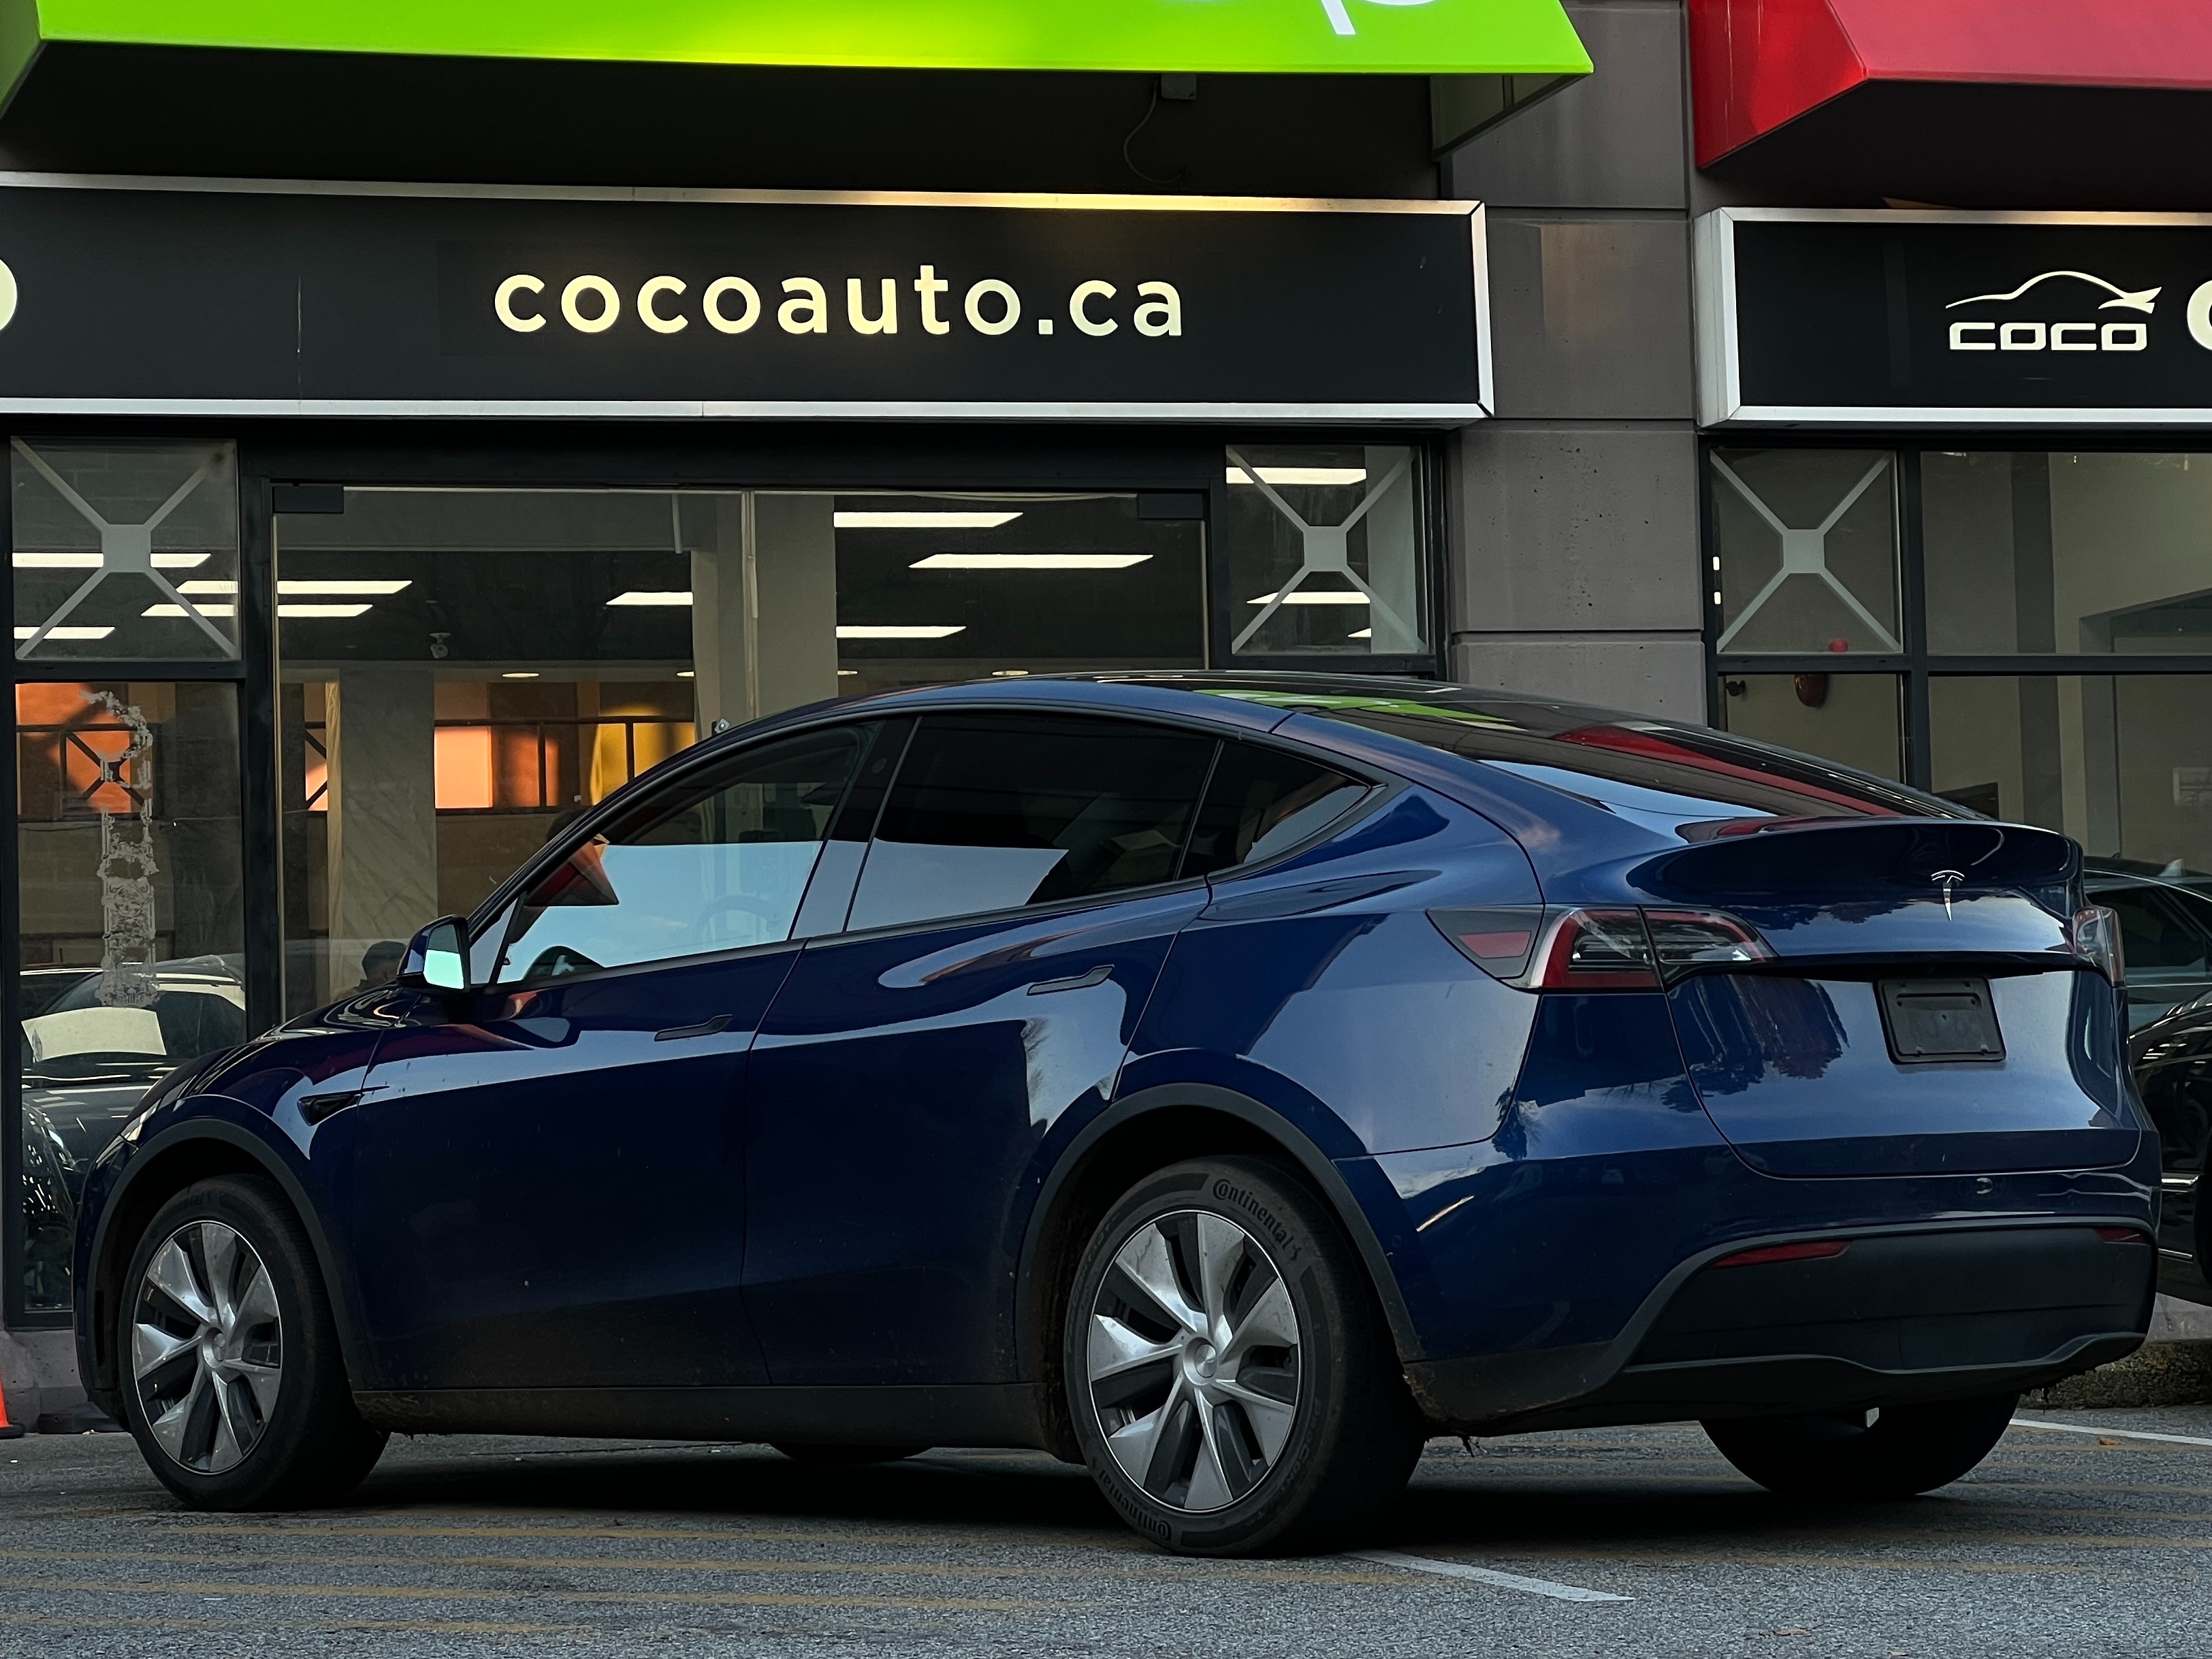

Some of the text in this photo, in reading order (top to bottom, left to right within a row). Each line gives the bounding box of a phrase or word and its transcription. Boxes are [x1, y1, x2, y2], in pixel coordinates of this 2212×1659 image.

[494, 265, 1182, 337] cocoauto.ca
[1212, 1178, 1296, 1251] Continental
[1098, 1468, 1172, 1541] Continental
